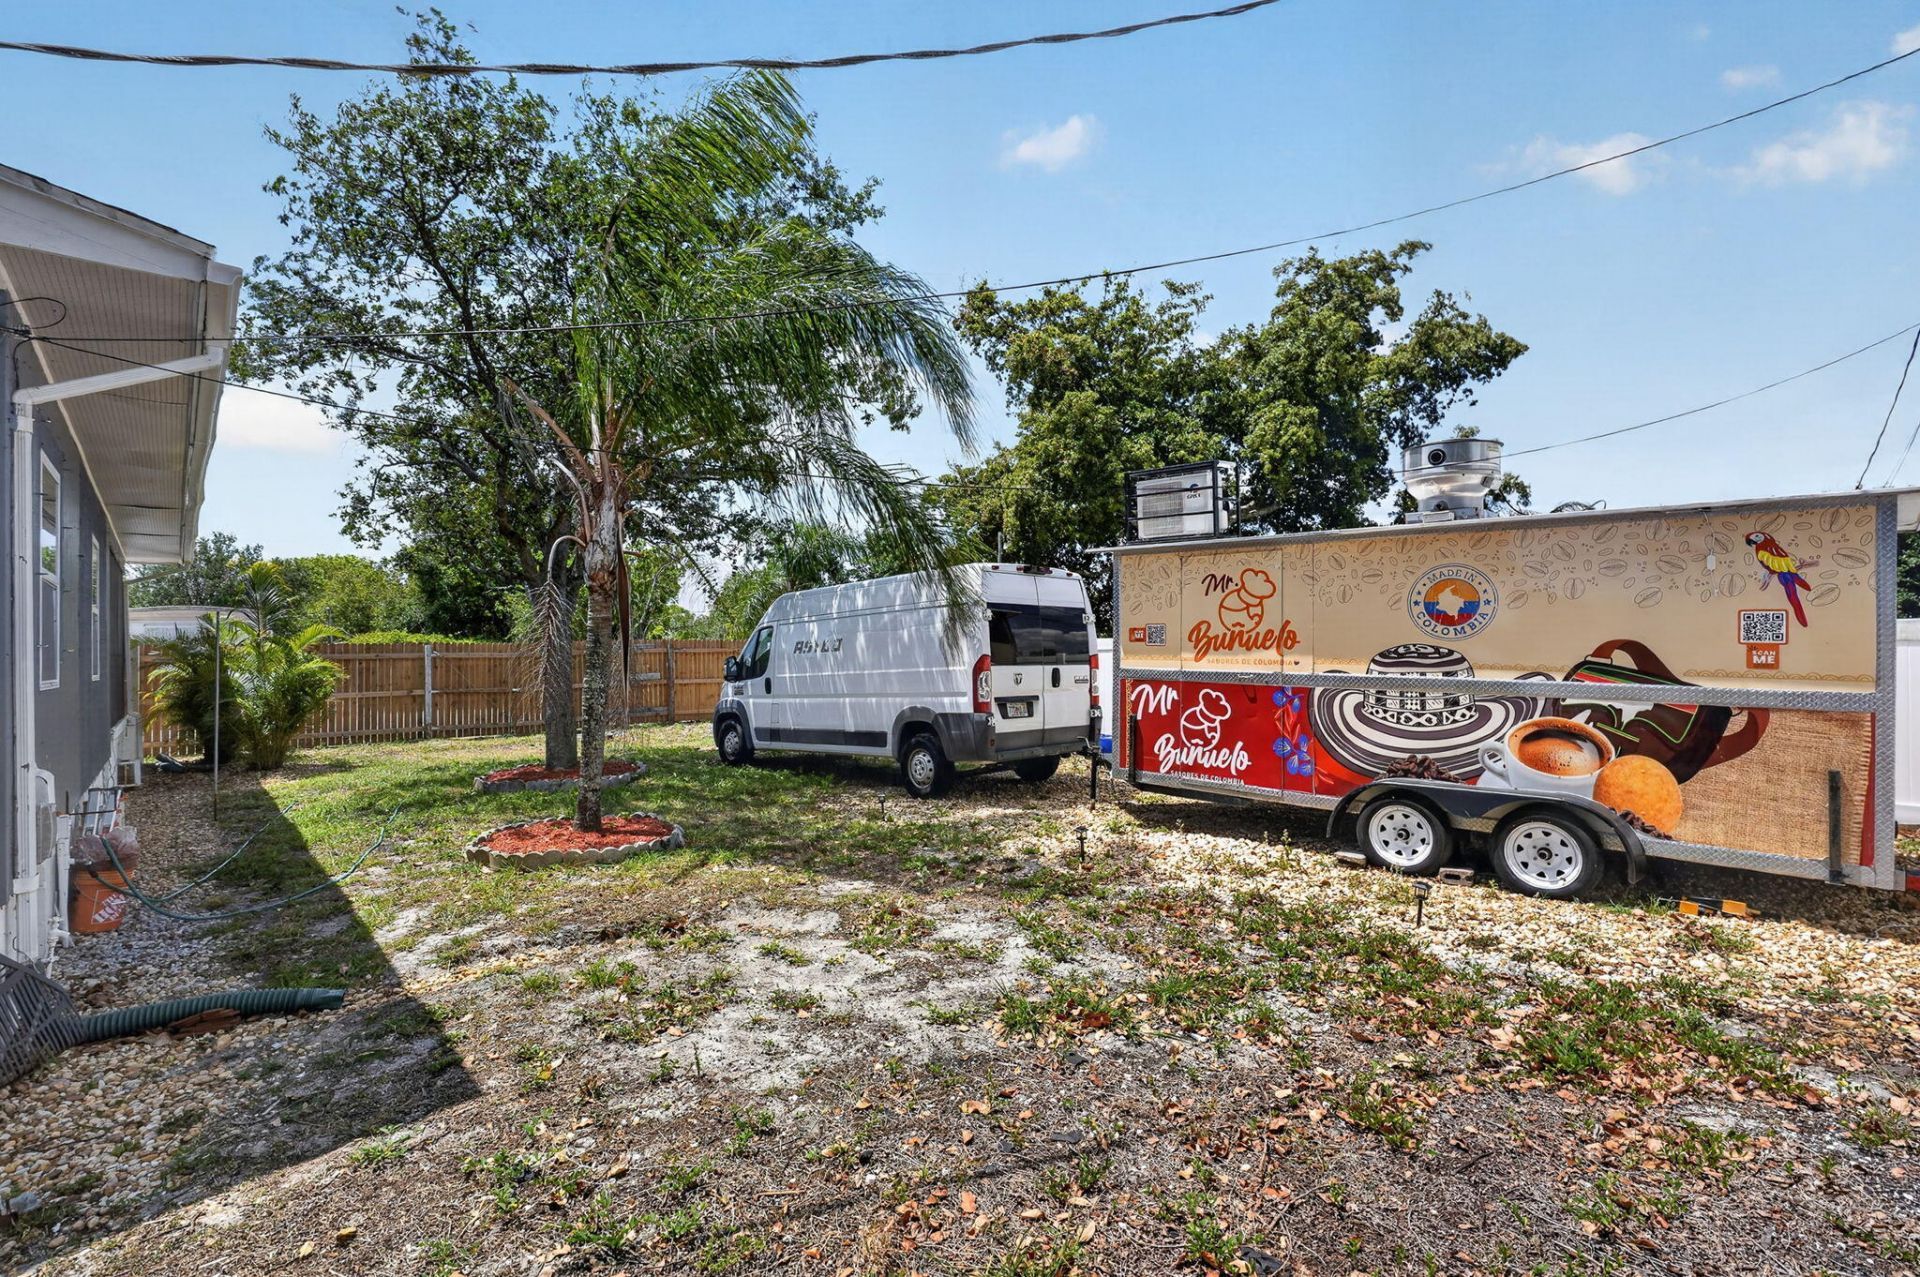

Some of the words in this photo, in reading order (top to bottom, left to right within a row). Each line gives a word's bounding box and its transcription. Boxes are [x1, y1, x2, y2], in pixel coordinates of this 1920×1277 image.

[1201, 573, 1239, 597] Mr.
[1427, 569, 1462, 583] MADE
[1464, 571, 1478, 583] IN
[1416, 611, 1489, 636] COLOMBIA
[1187, 619, 1301, 663] Buñuelo
[1253, 658, 1293, 666] COLOMBIA
[1753, 655, 1776, 664] ME
[1130, 683, 1179, 721] Mr
[1153, 733, 1252, 776] Buñuelo
[1170, 770, 1199, 779] SABORES
[1200, 773, 1209, 781] DE
[1210, 774, 1245, 785] COLOMBIA
